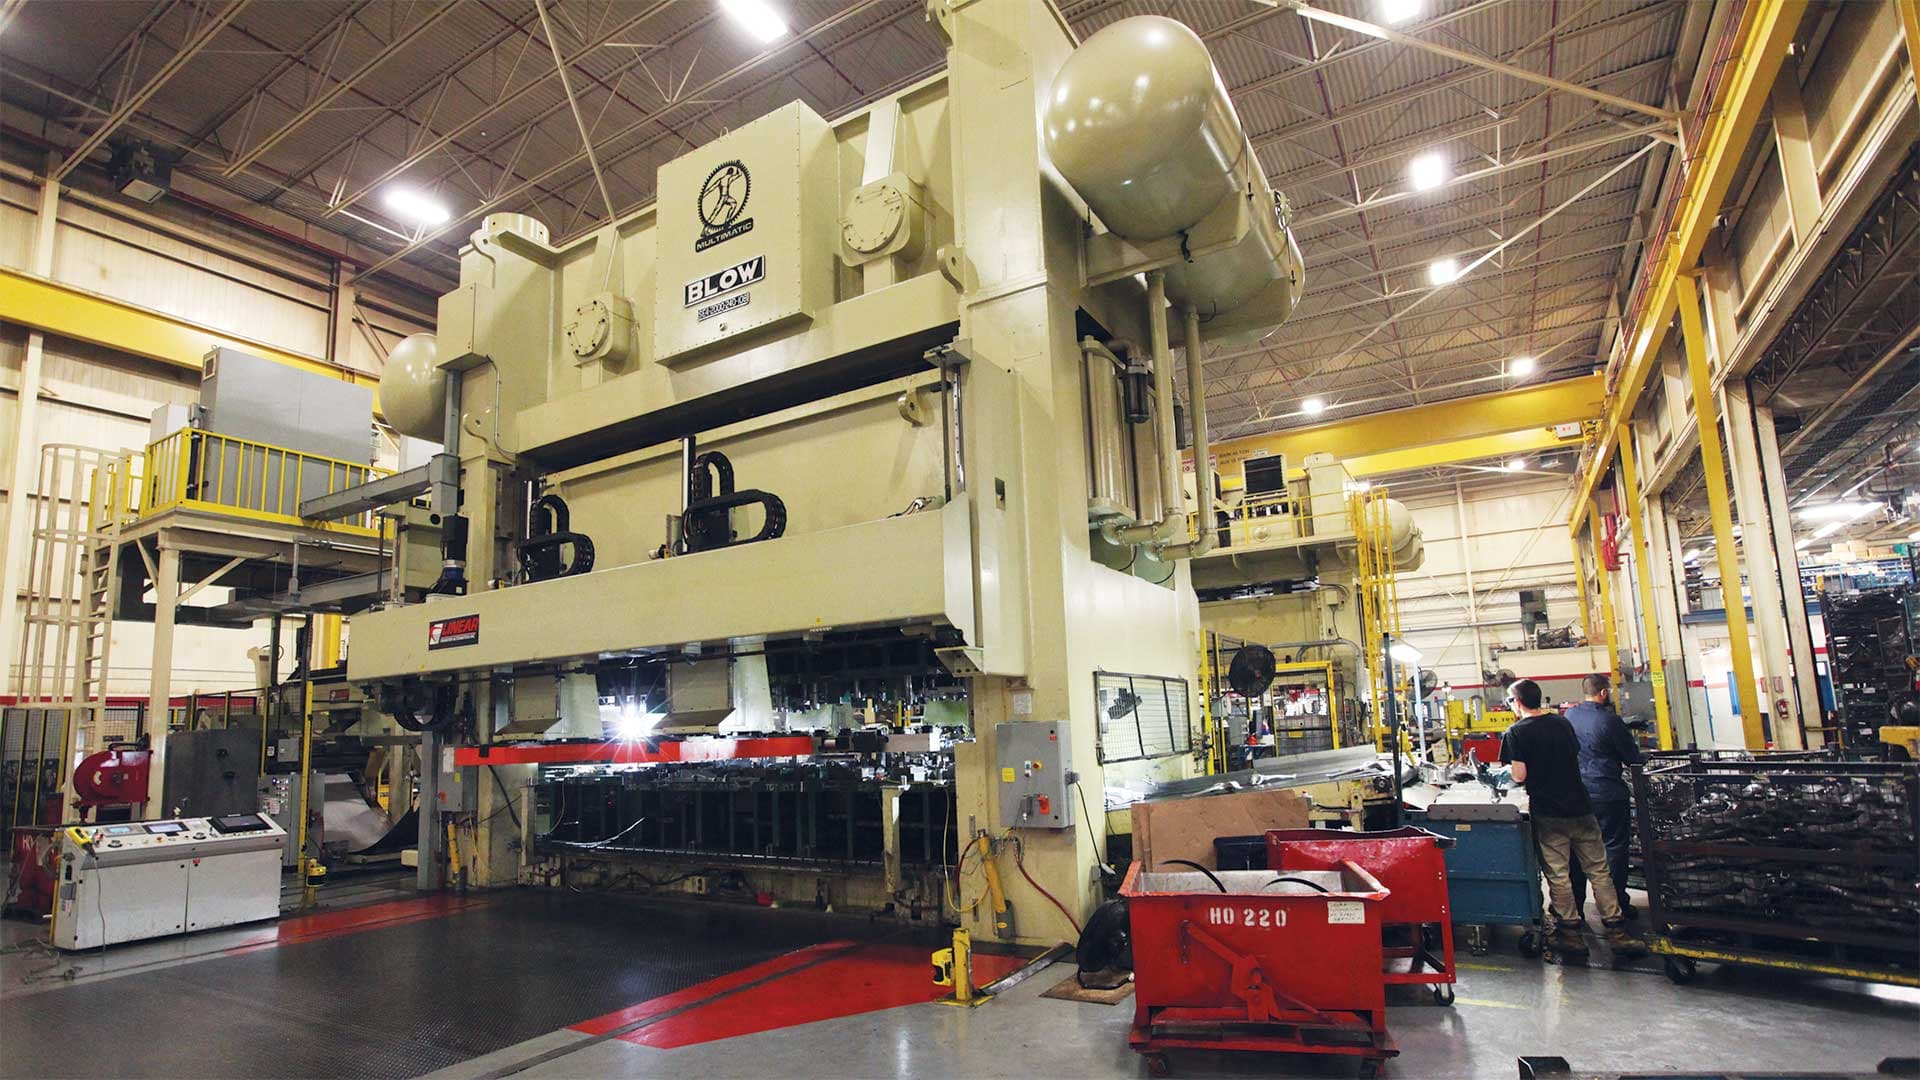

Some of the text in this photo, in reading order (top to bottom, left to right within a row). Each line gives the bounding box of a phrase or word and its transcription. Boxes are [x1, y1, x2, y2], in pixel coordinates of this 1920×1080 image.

[697, 222, 752, 251] MULTIMATIC
[688, 259, 759, 304] BLOW
[442, 616, 479, 636] LINEAR
[1209, 907, 1287, 927] HO 220
